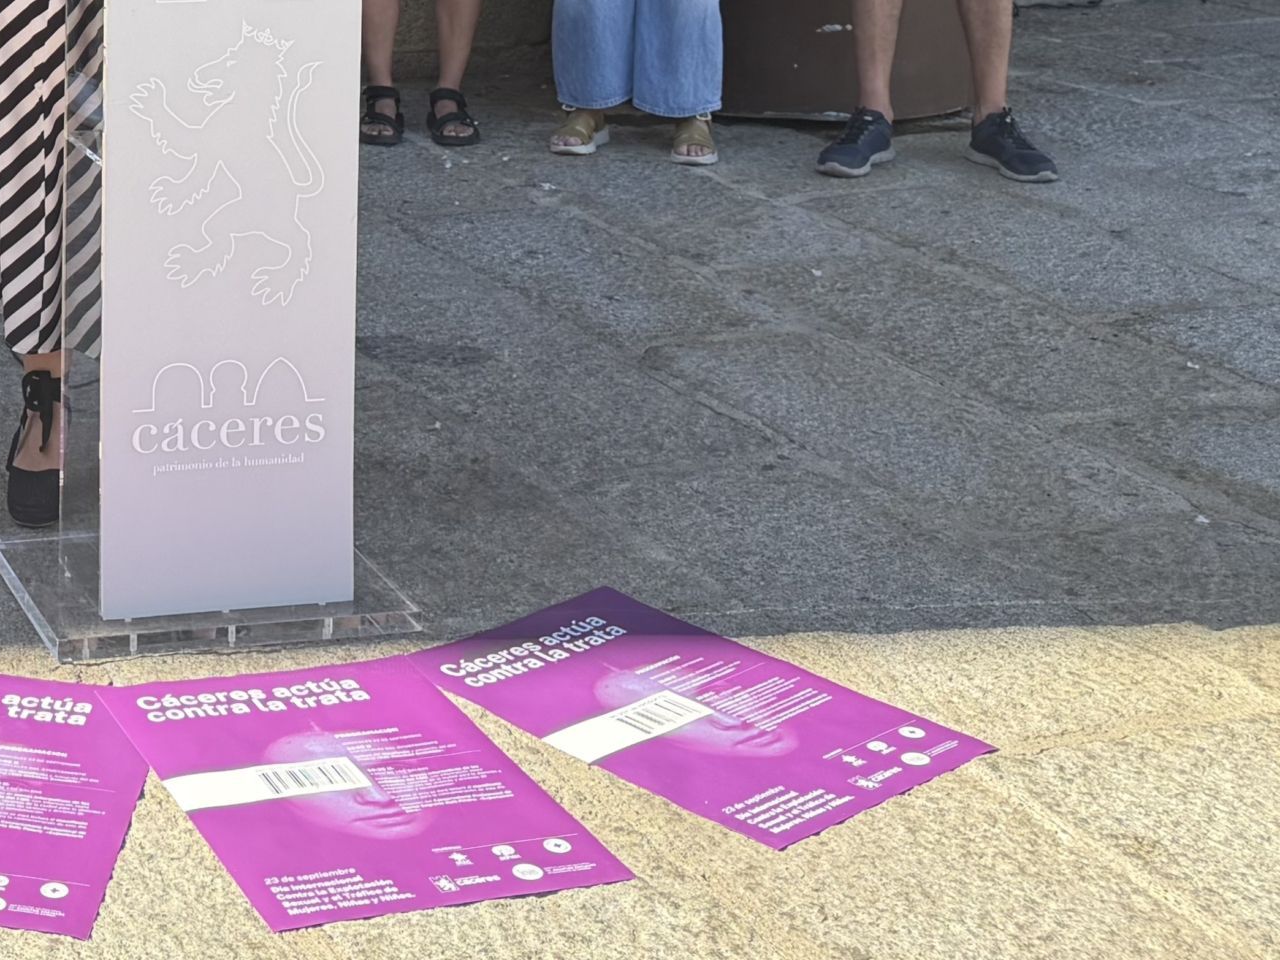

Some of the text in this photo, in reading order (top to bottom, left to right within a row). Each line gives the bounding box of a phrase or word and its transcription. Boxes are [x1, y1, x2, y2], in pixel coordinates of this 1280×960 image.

[131, 413, 326, 454] cáceres
[153, 452, 305, 477] patrimonio de la humanidad
[439, 616, 607, 677] Cáceres actúa
[464, 625, 627, 688] contra la trata
[1, 693, 93, 714] actúa
[136, 677, 360, 710] Cáceres actúa
[147, 688, 371, 723] contra la trata
[7, 705, 87, 726] trata
